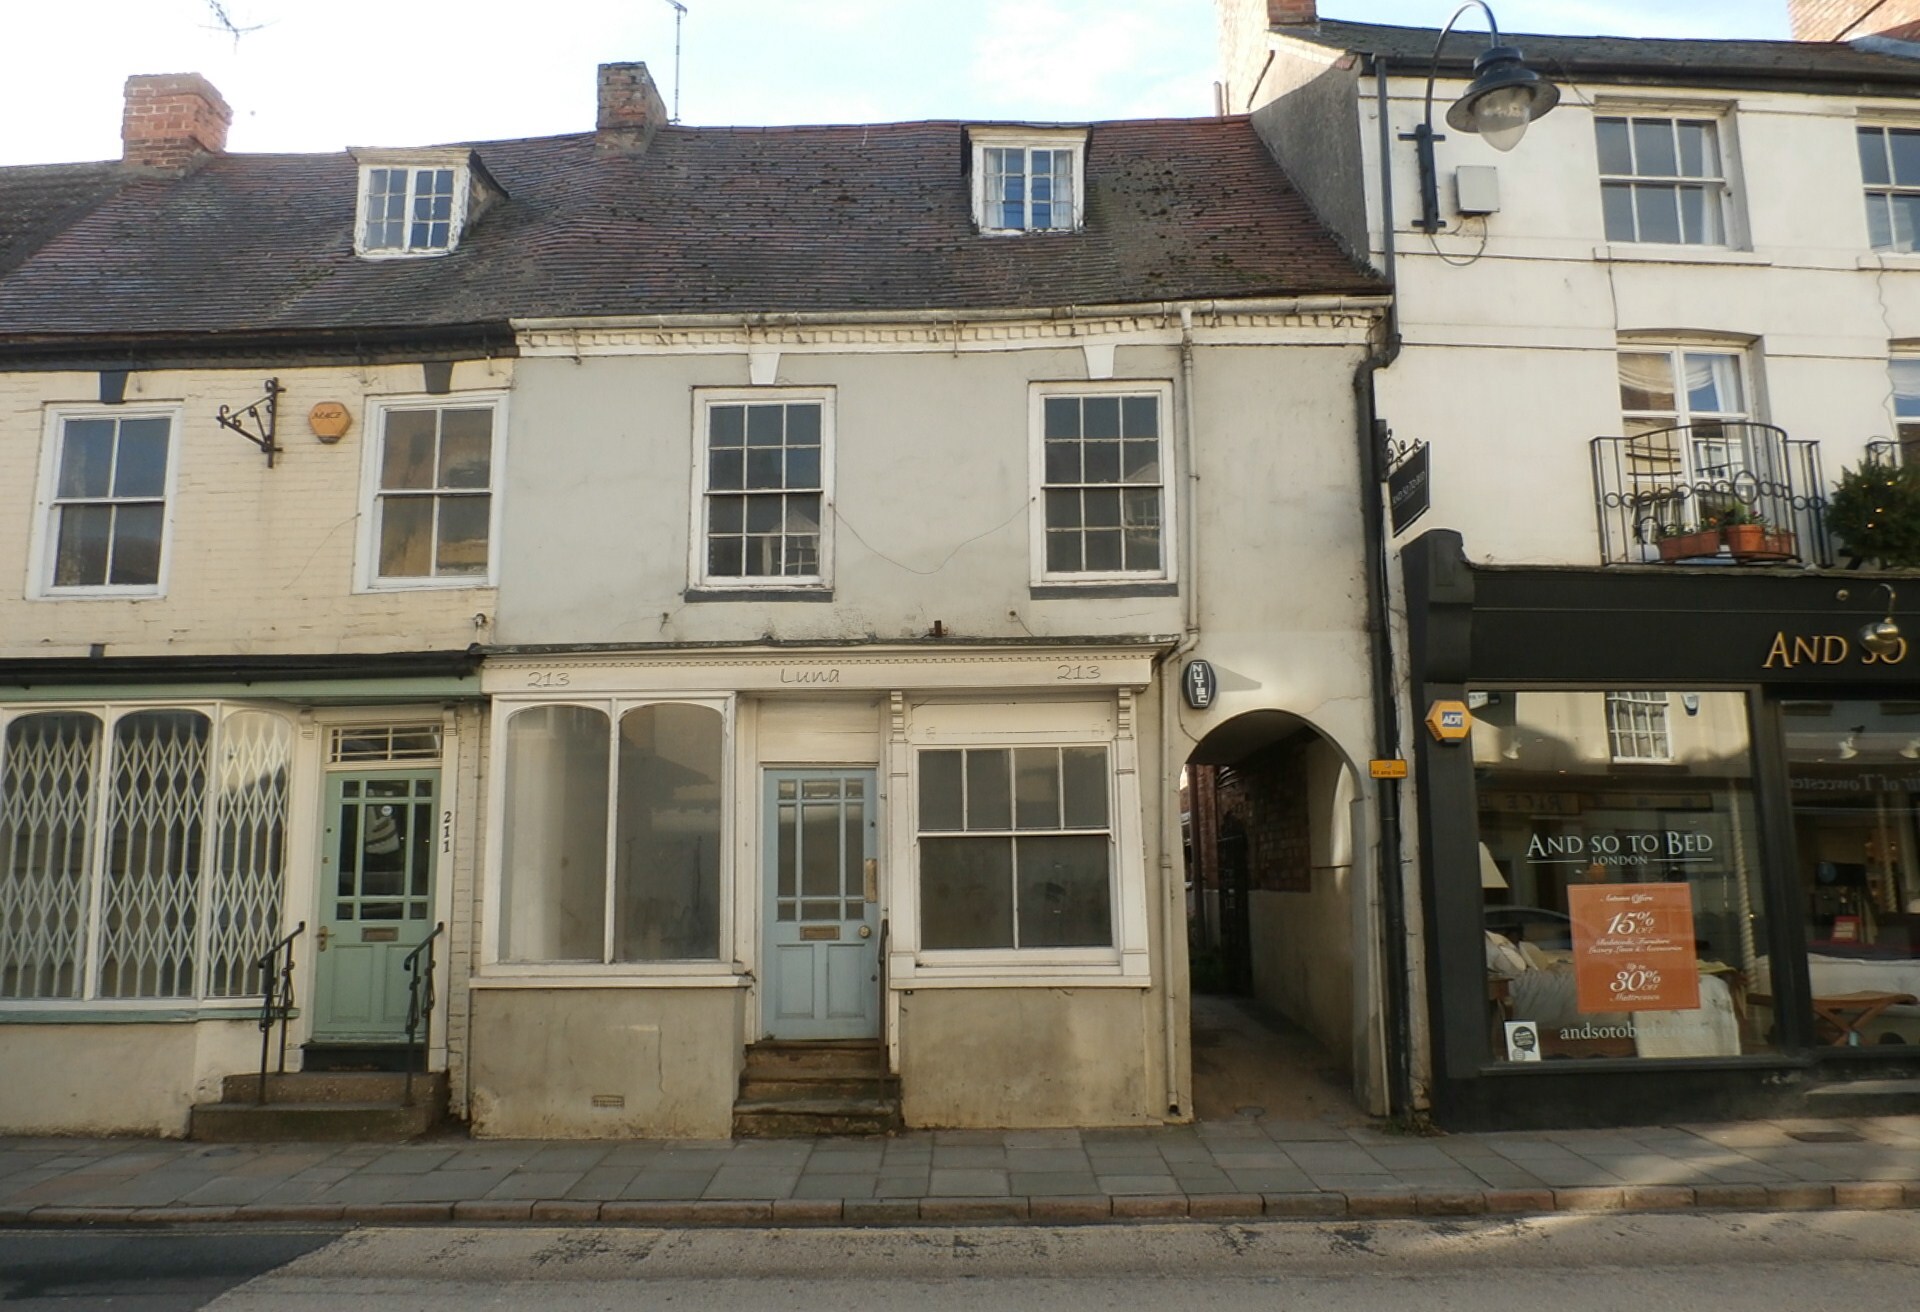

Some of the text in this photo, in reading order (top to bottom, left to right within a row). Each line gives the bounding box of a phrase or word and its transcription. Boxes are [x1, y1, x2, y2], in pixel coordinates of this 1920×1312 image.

[1761, 631, 1849, 669] AND
[527, 671, 570, 688] 213
[780, 668, 840, 684] Luna
[1056, 664, 1101, 681] 213
[1442, 714, 1464, 725] ADT
[444, 811, 452, 853] 211
[1526, 833, 1584, 858] AND
[1666, 831, 1713, 855] BED
[1592, 855, 1648, 866] LONDON
[1608, 911, 1655, 935] 15%
[1609, 969, 1661, 993] 30%
